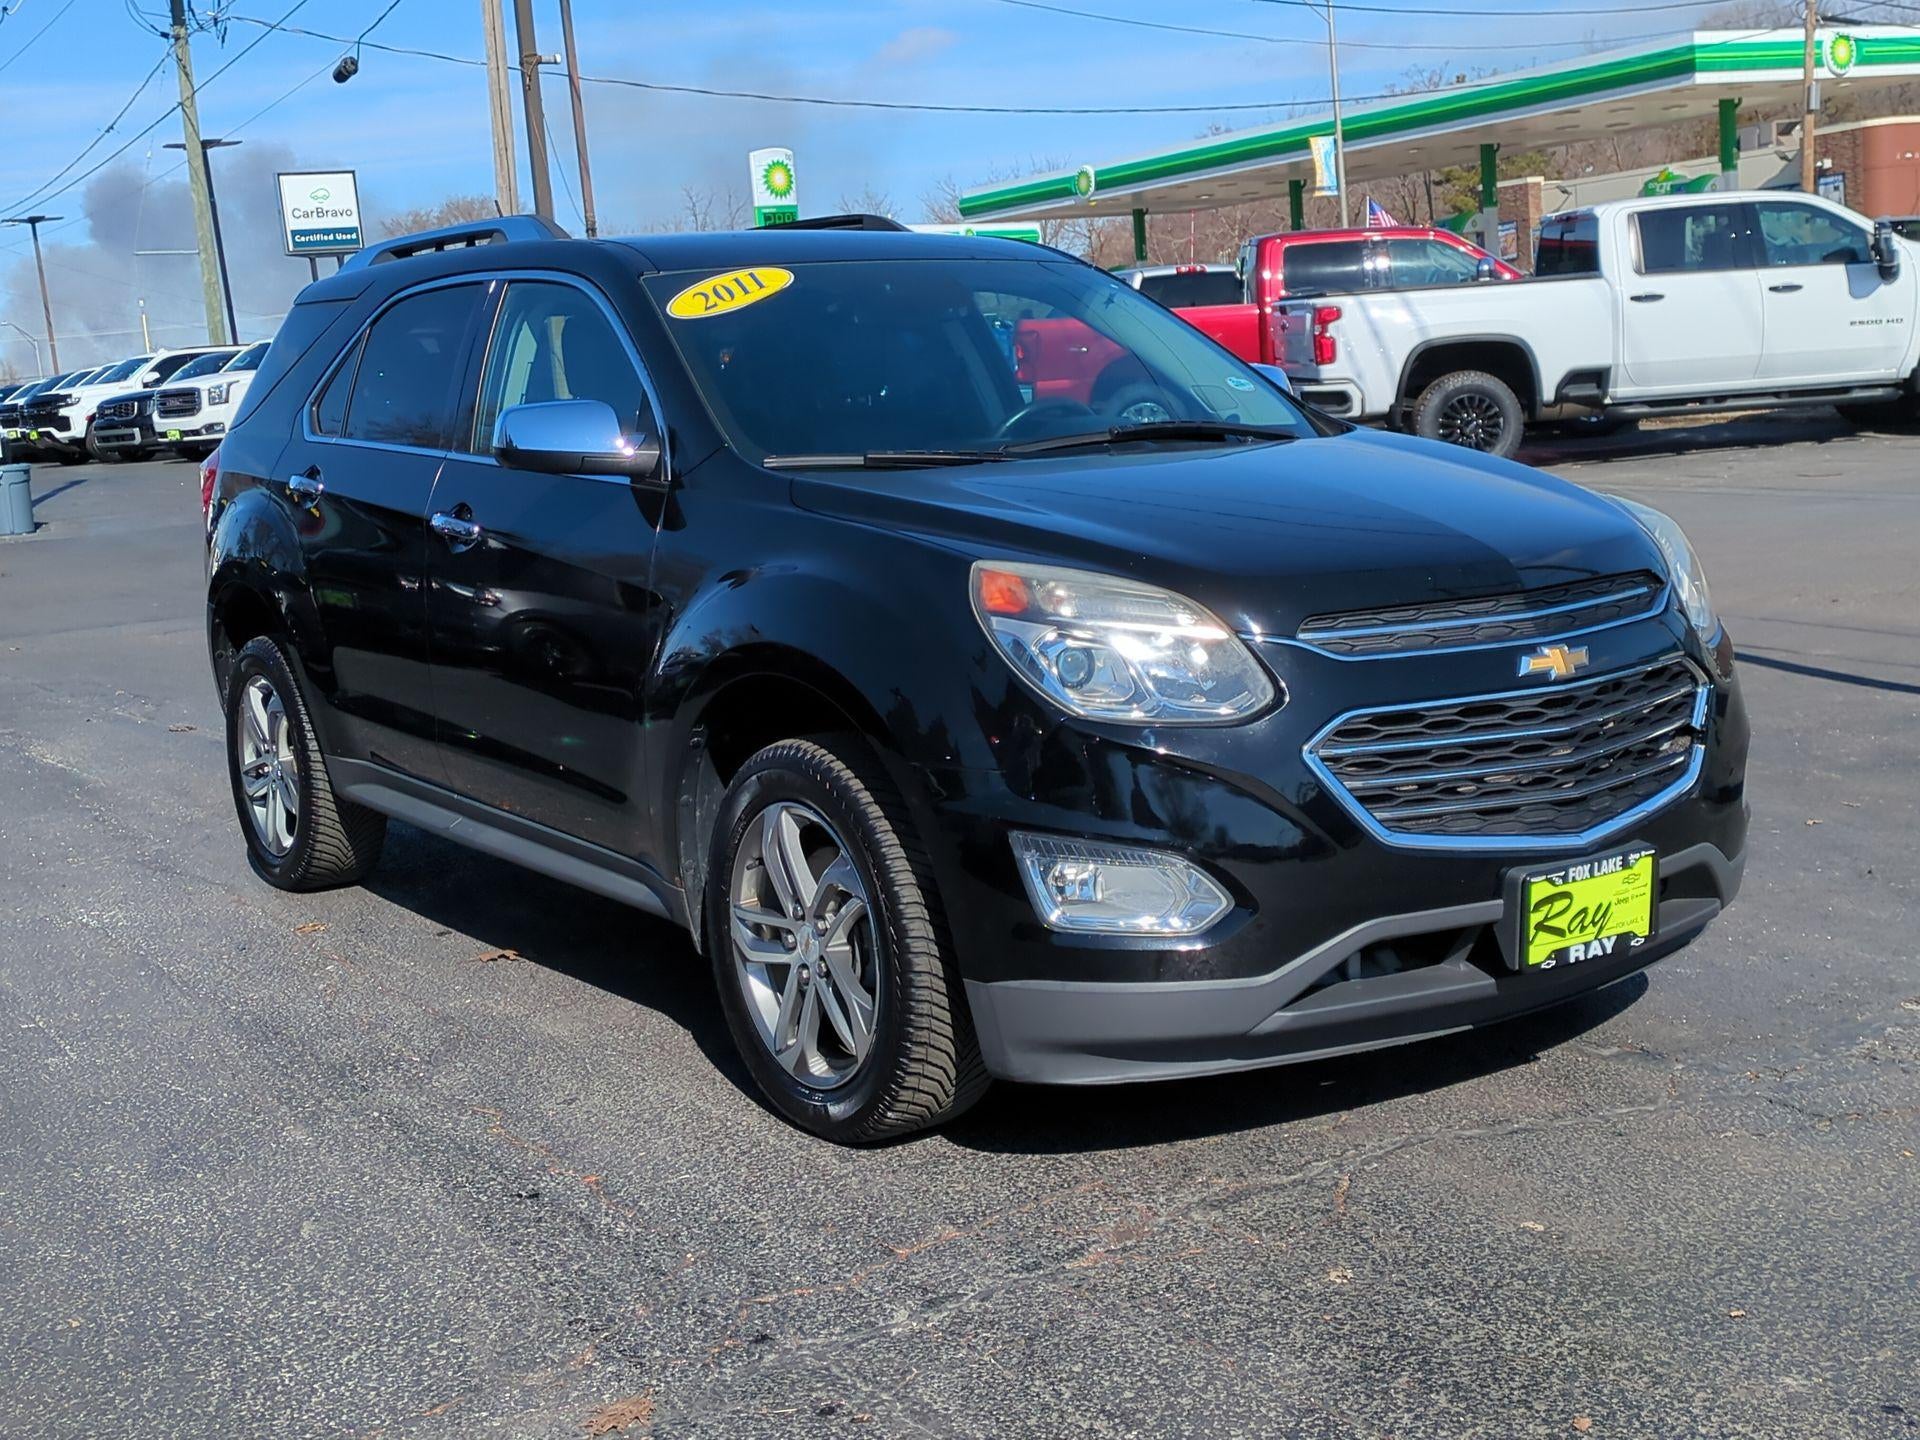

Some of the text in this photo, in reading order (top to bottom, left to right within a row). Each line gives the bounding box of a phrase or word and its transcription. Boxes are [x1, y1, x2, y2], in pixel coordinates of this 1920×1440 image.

[291, 207, 353, 219] CarBravo
[294, 231, 358, 242] Certified Used
[692, 271, 767, 312] 2011
[1568, 863, 1591, 883] FOX
[1594, 855, 1623, 877] LAKE
[1529, 890, 1613, 945] Ray
[1568, 935, 1618, 964] RAY
